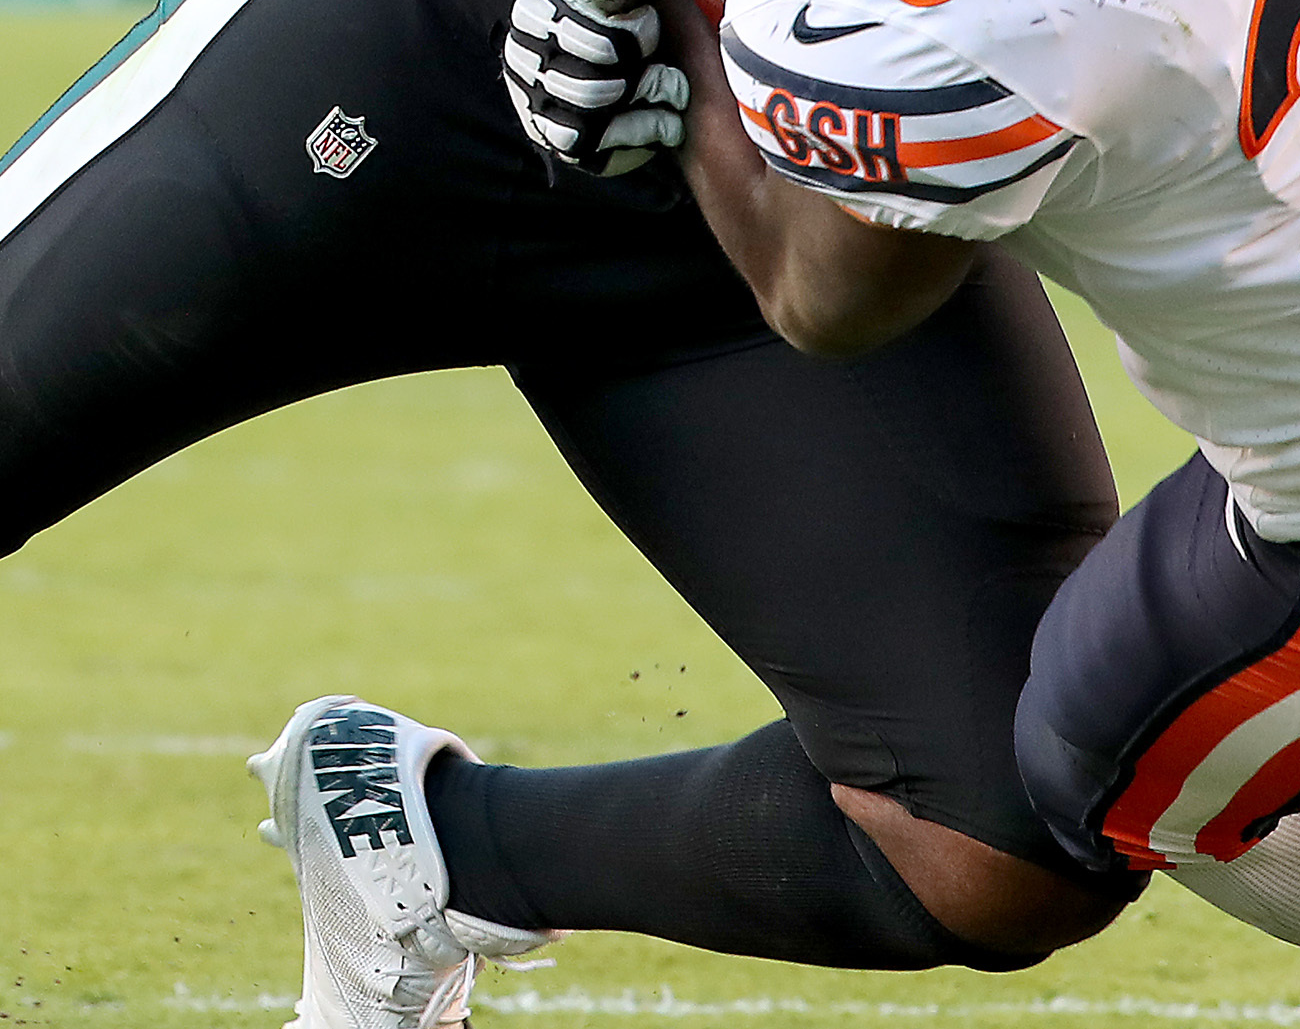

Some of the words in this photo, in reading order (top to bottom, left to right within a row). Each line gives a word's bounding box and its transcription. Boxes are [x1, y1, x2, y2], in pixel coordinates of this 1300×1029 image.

[315, 130, 353, 170] NFL
[764, 86, 909, 183] GSH
[309, 708, 416, 859] NIKE
